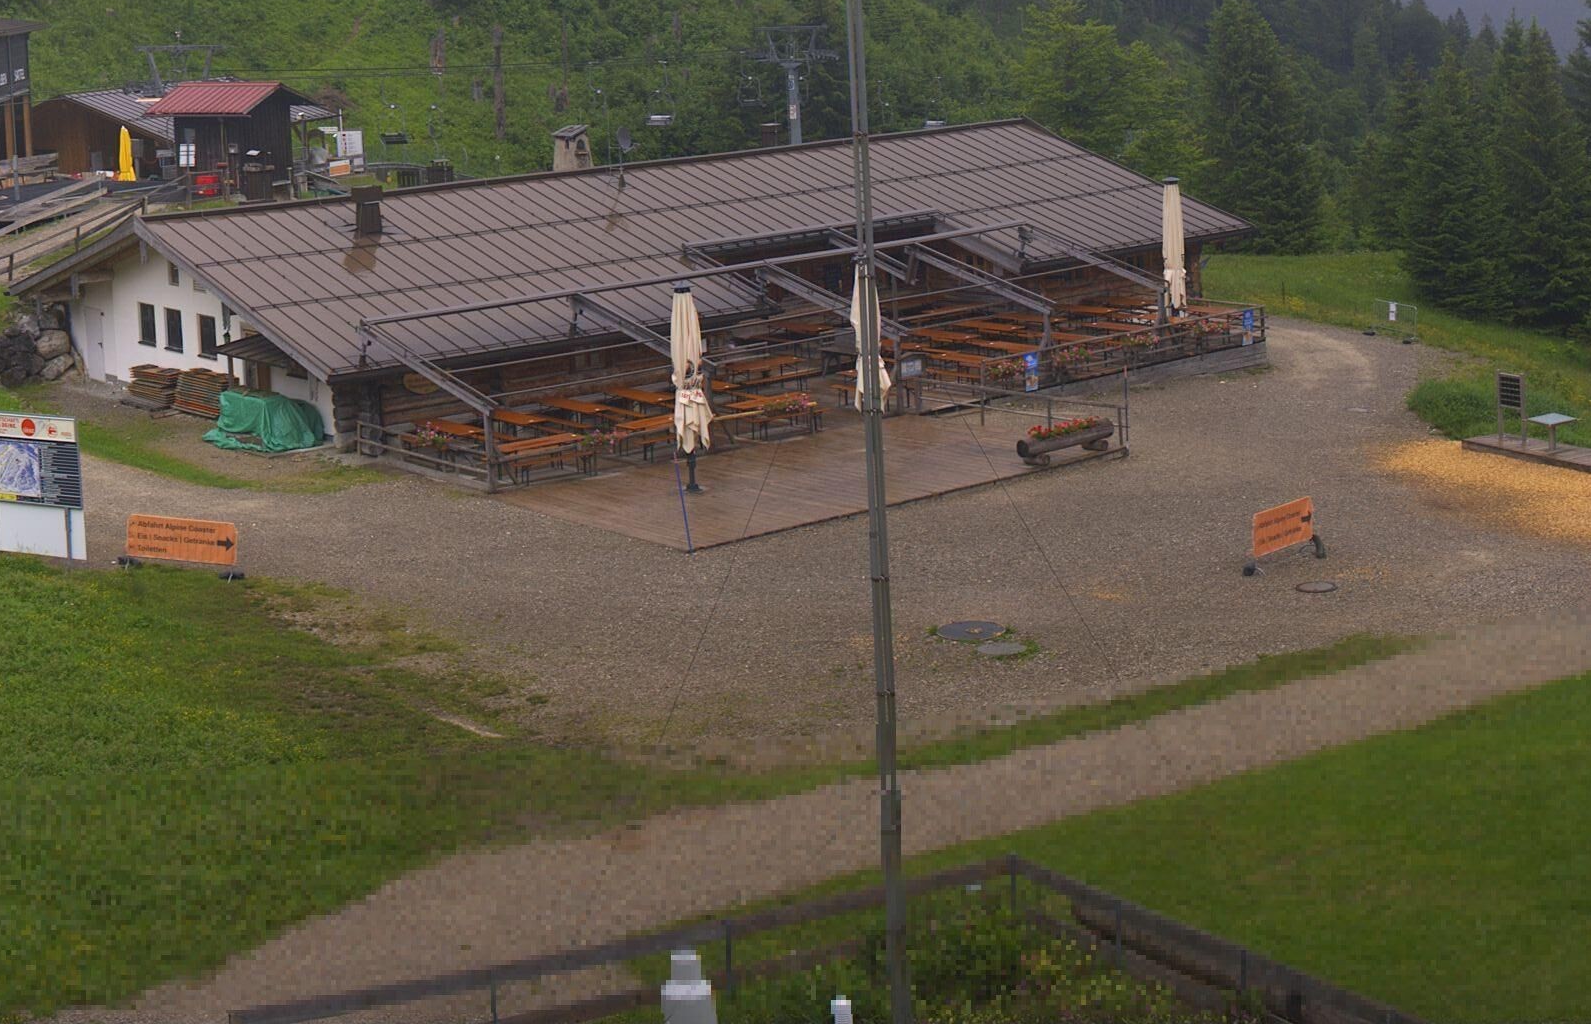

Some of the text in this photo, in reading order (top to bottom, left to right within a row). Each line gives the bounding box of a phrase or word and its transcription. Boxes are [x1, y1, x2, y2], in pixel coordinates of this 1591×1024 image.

[138, 521, 215, 534] Abfahrt Alpine Coaster
[153, 534, 178, 542] Snacks
[137, 545, 167, 553] Toiletten
